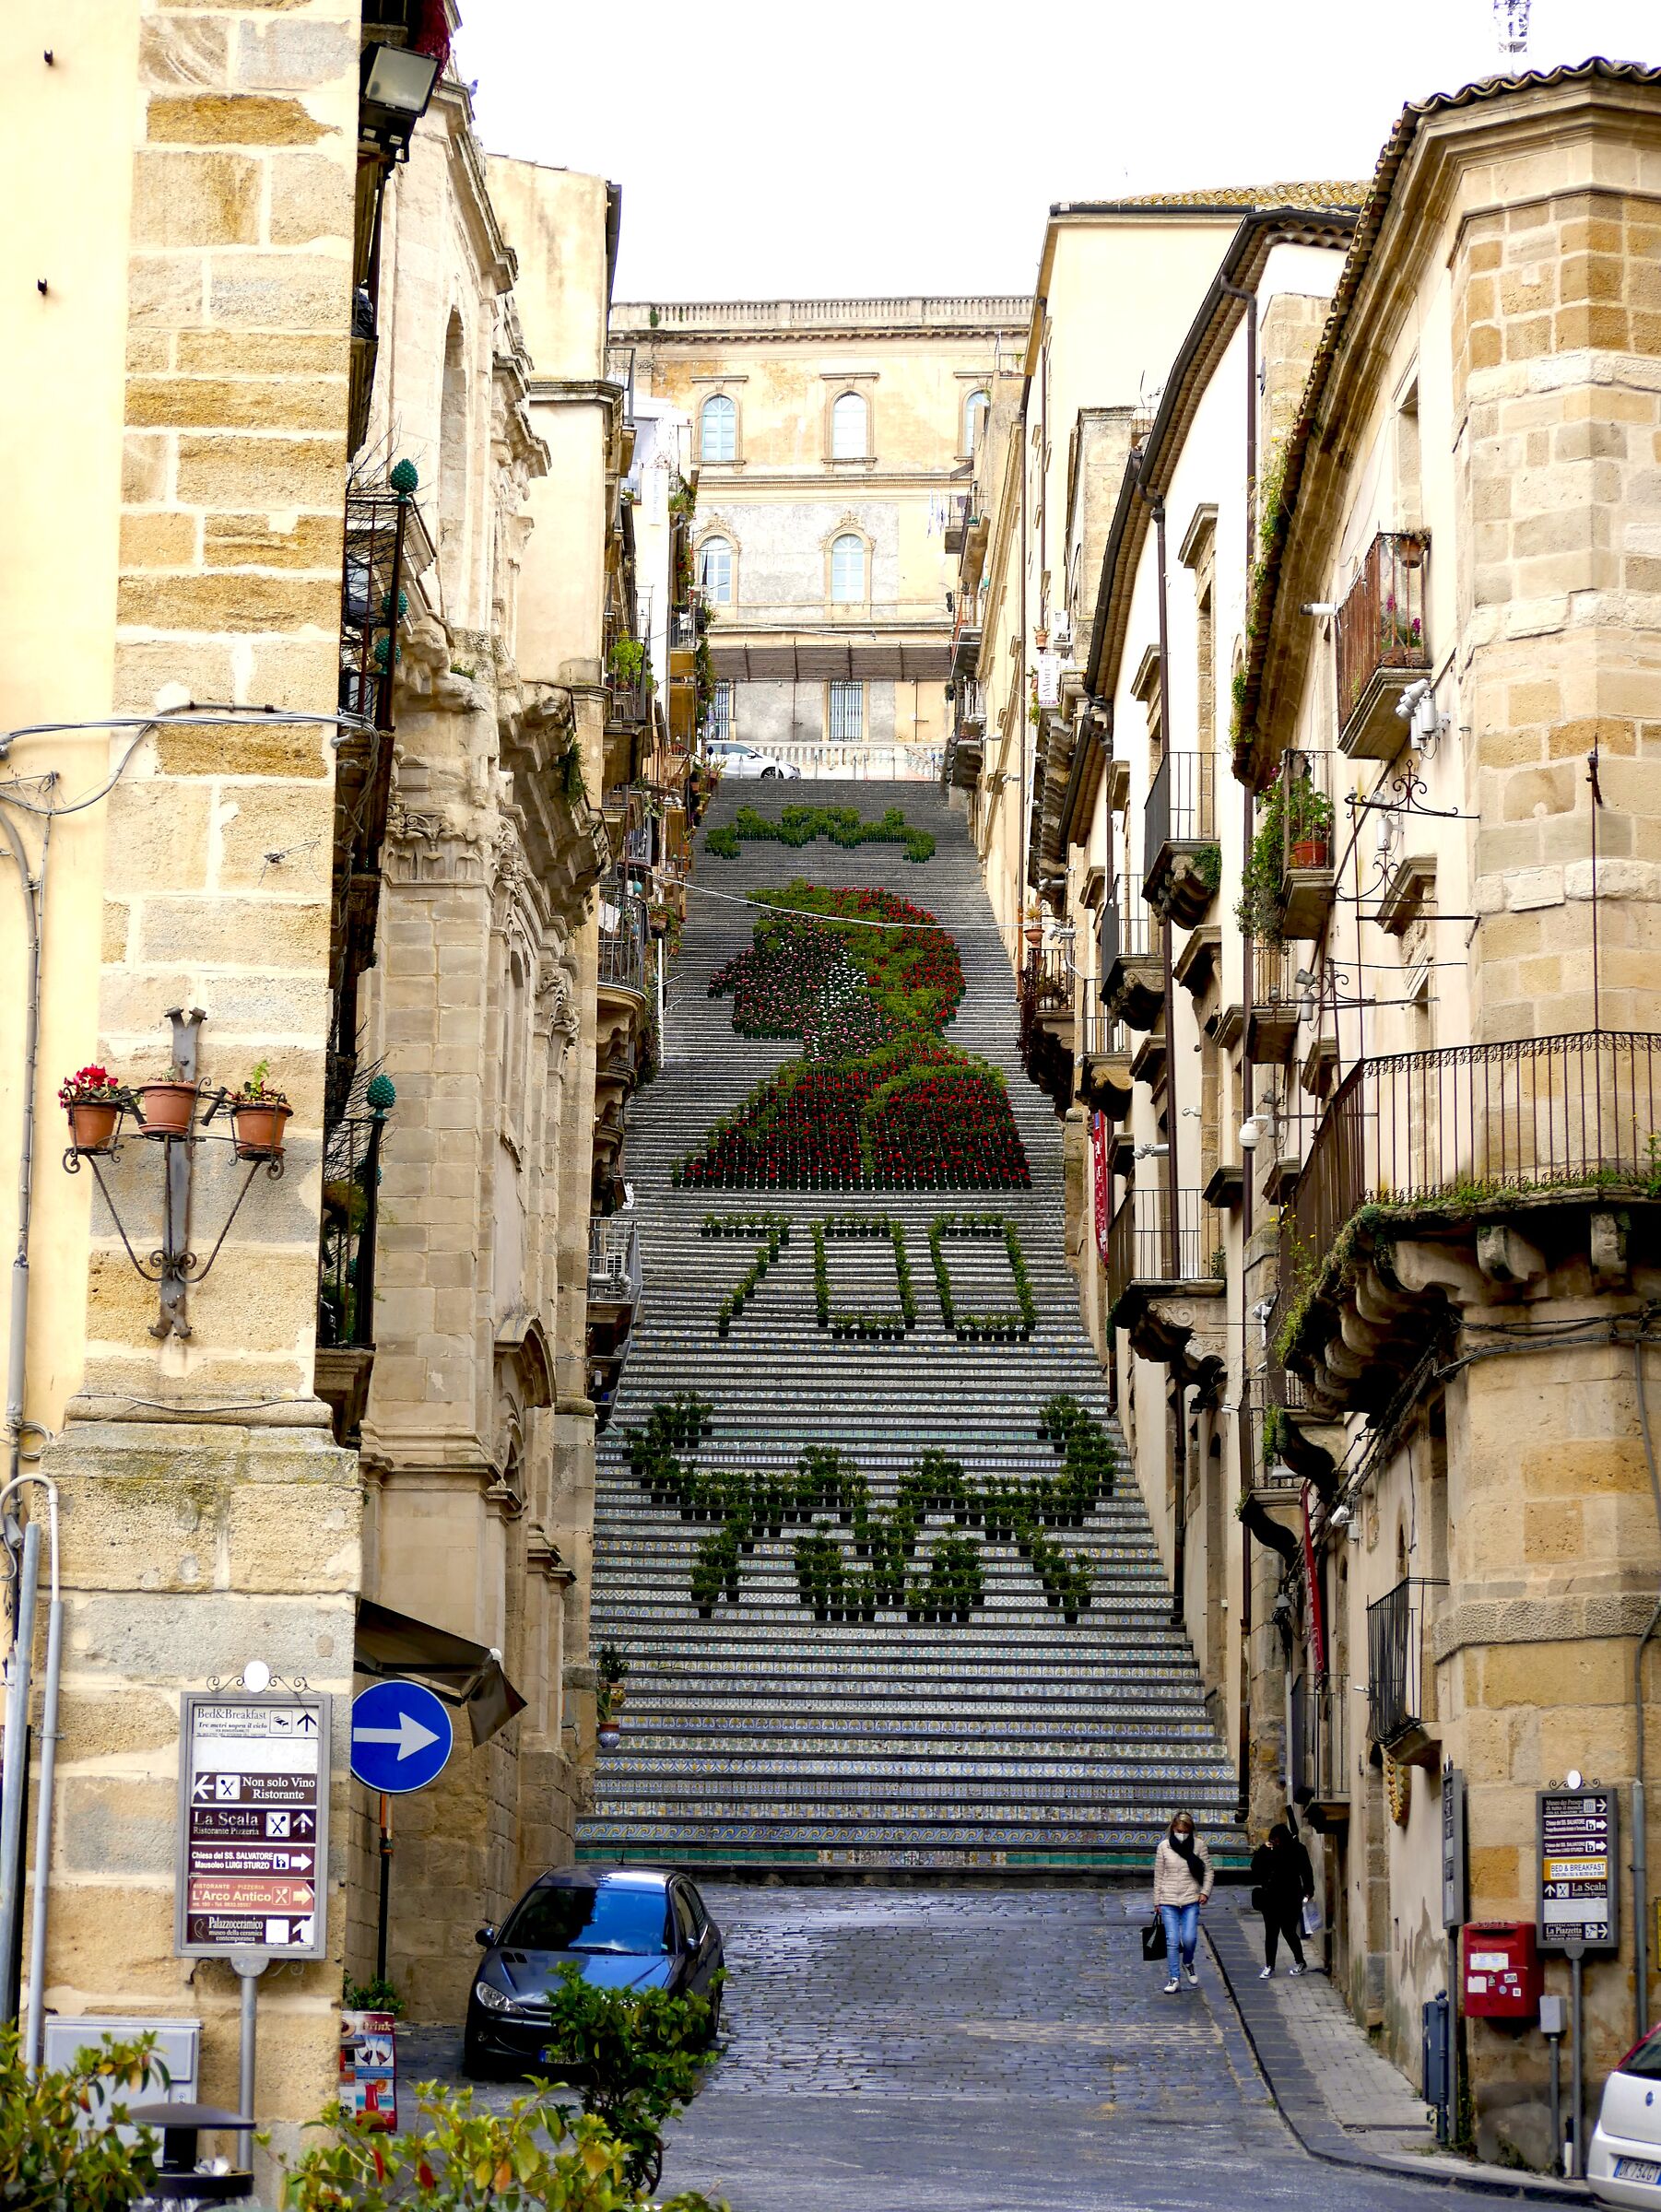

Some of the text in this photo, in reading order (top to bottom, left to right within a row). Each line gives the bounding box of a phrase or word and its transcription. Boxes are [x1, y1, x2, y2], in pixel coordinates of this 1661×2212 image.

[700, 1212, 1036, 1342] 700
[197, 1708, 266, 1720] Bed&Breakfast
[242, 1777, 315, 1788] Non solo Vino
[253, 1789, 305, 1799] Ristorante
[194, 1812, 258, 1826] La Scala
[193, 1827, 260, 1835] Ristorante Pizzeria
[236, 1852, 273, 1860] SALVATORE
[1572, 1882, 1606, 1892] La Scala
[192, 1890, 271, 1902] L'Arco Antico
[209, 1917, 263, 1930] Palazzoceramico
